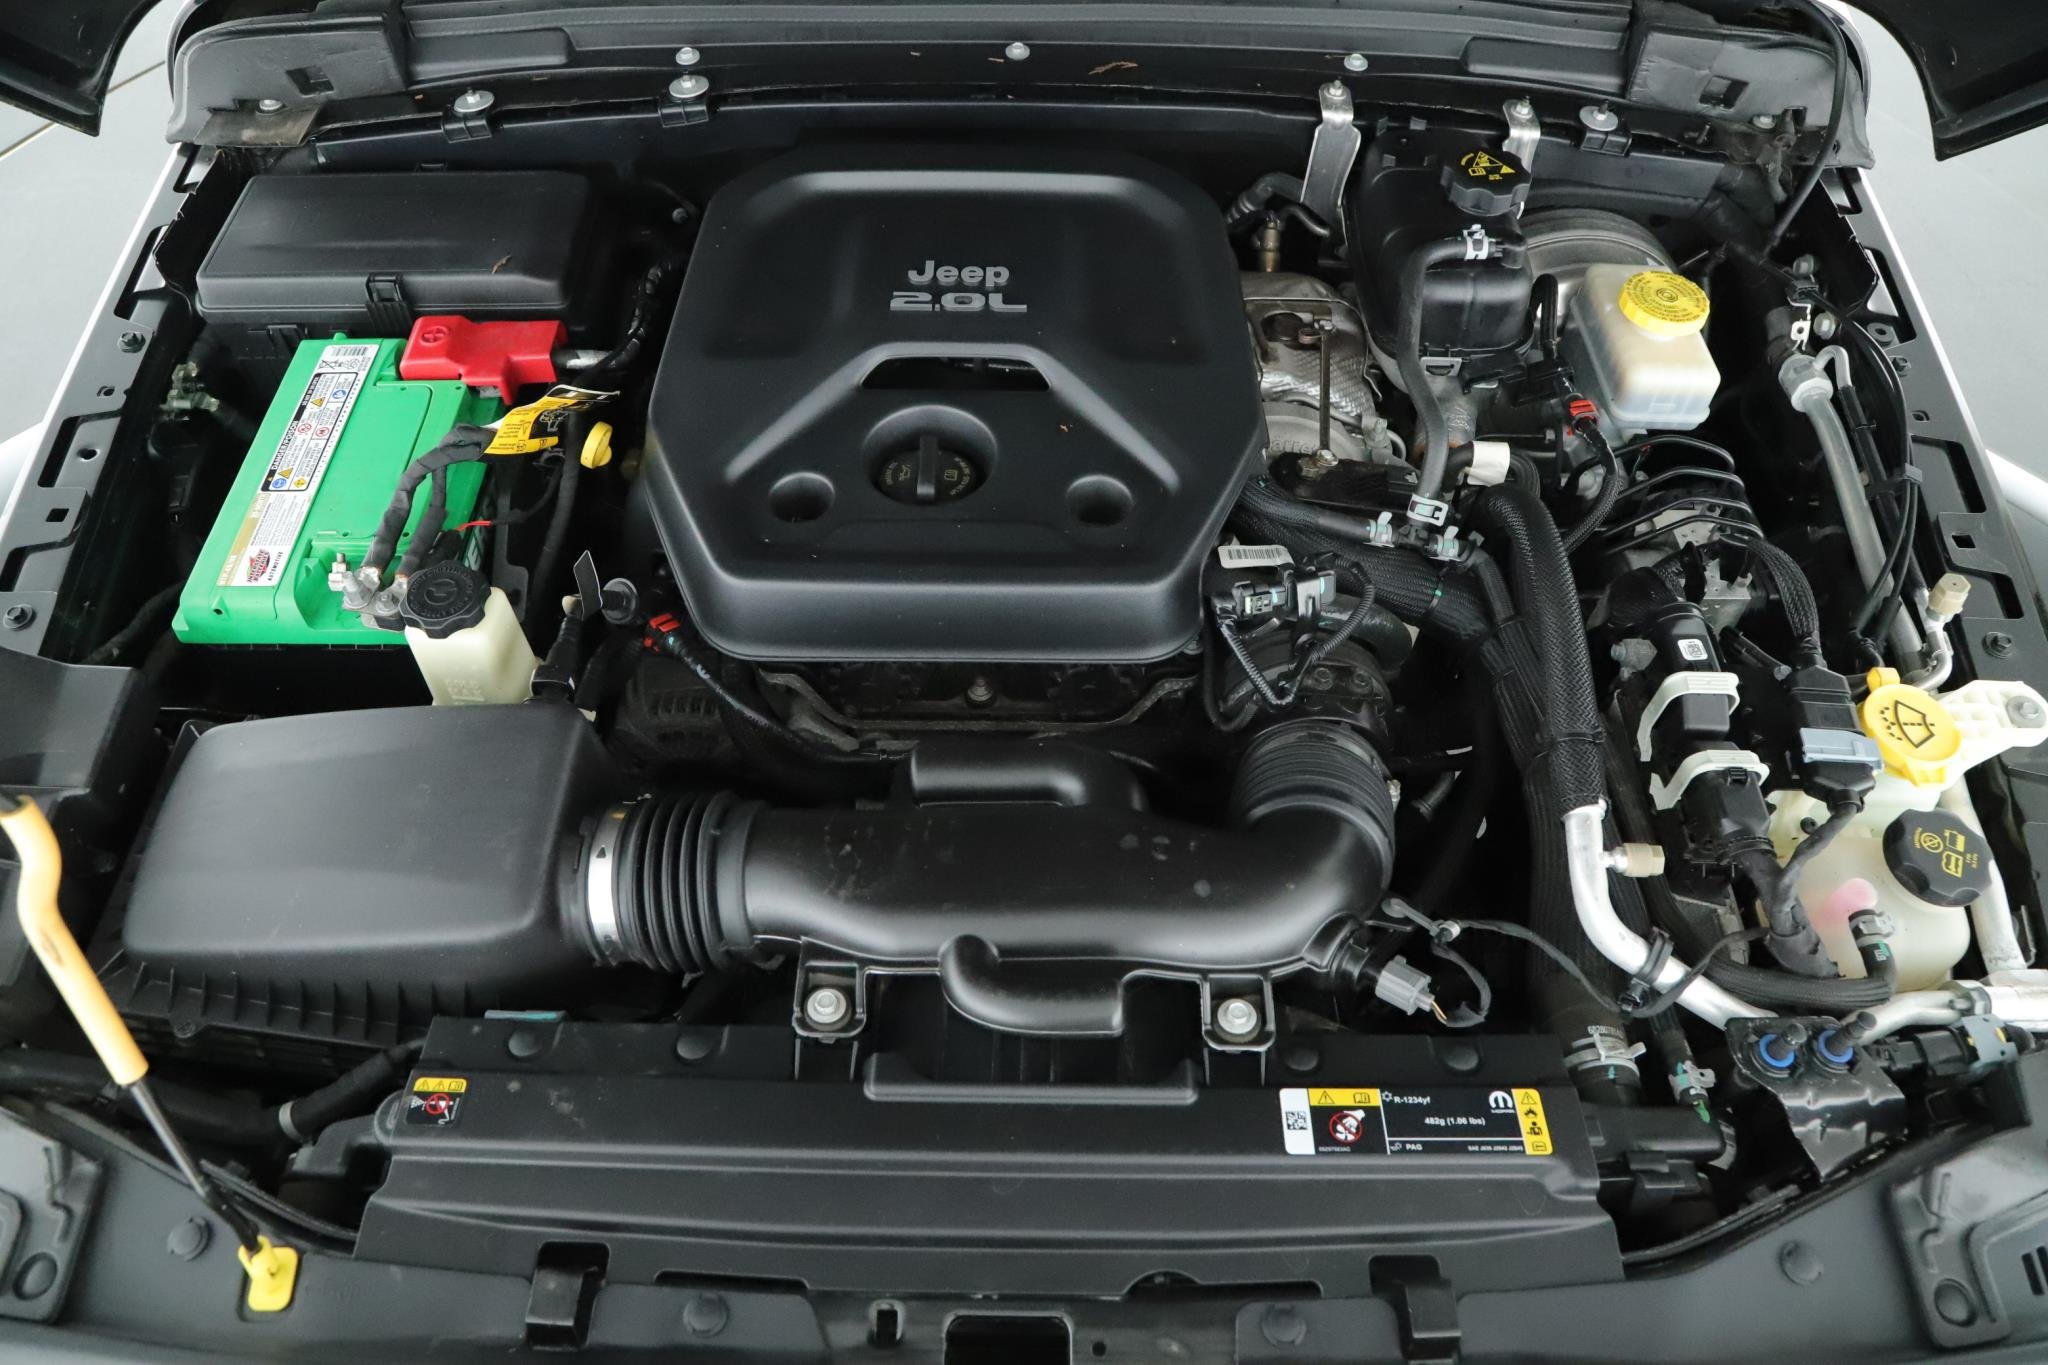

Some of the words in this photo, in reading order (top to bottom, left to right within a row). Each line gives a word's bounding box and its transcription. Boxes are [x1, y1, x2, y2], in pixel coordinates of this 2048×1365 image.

[907, 260, 1010, 290] Jeep
[889, 291, 1028, 313] 2.0L
[271, 420, 299, 470] DANGER/POISON
[247, 549, 265, 583] INTERSTATE
[1393, 1095, 1431, 1106] R-1234yf
[1424, 1116, 1446, 1127] 482g
[1469, 1116, 1486, 1126] lbs)
[1405, 1143, 1423, 1151] PAG
